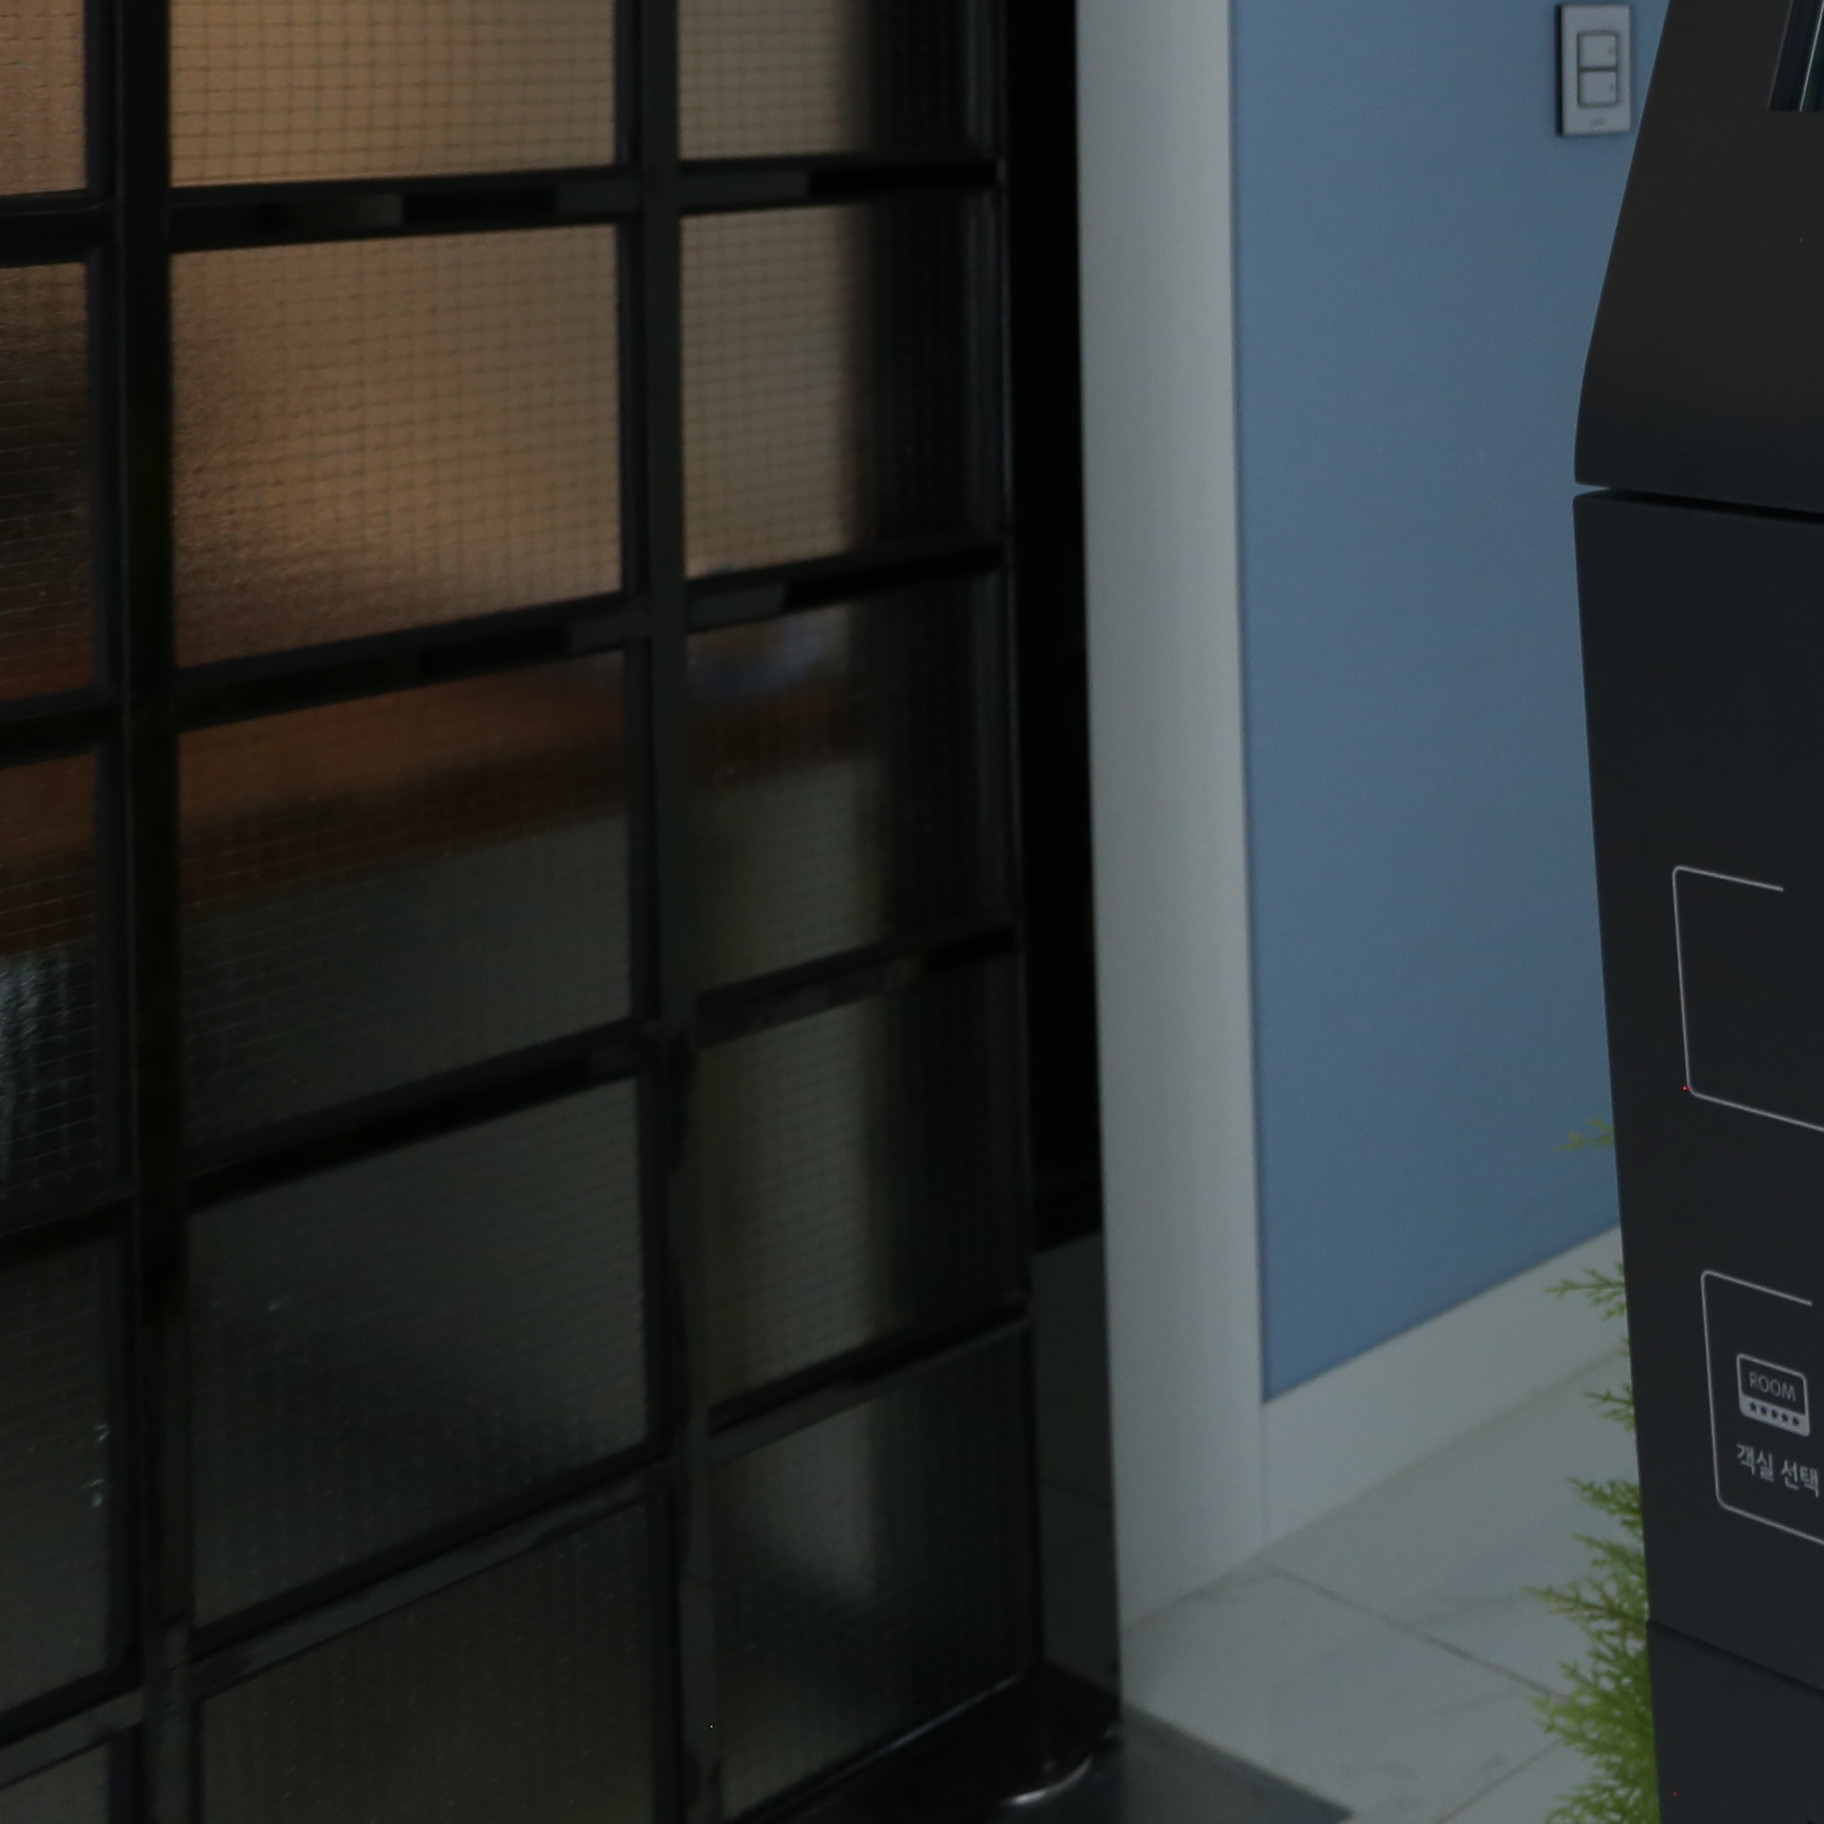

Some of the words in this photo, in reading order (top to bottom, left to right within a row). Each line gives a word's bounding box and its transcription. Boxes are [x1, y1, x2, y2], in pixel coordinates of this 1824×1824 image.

[1749, 1371, 1797, 1402] ROOM
[1736, 1443, 1775, 1483] 객실
[1780, 1459, 1820, 1498] 선택
